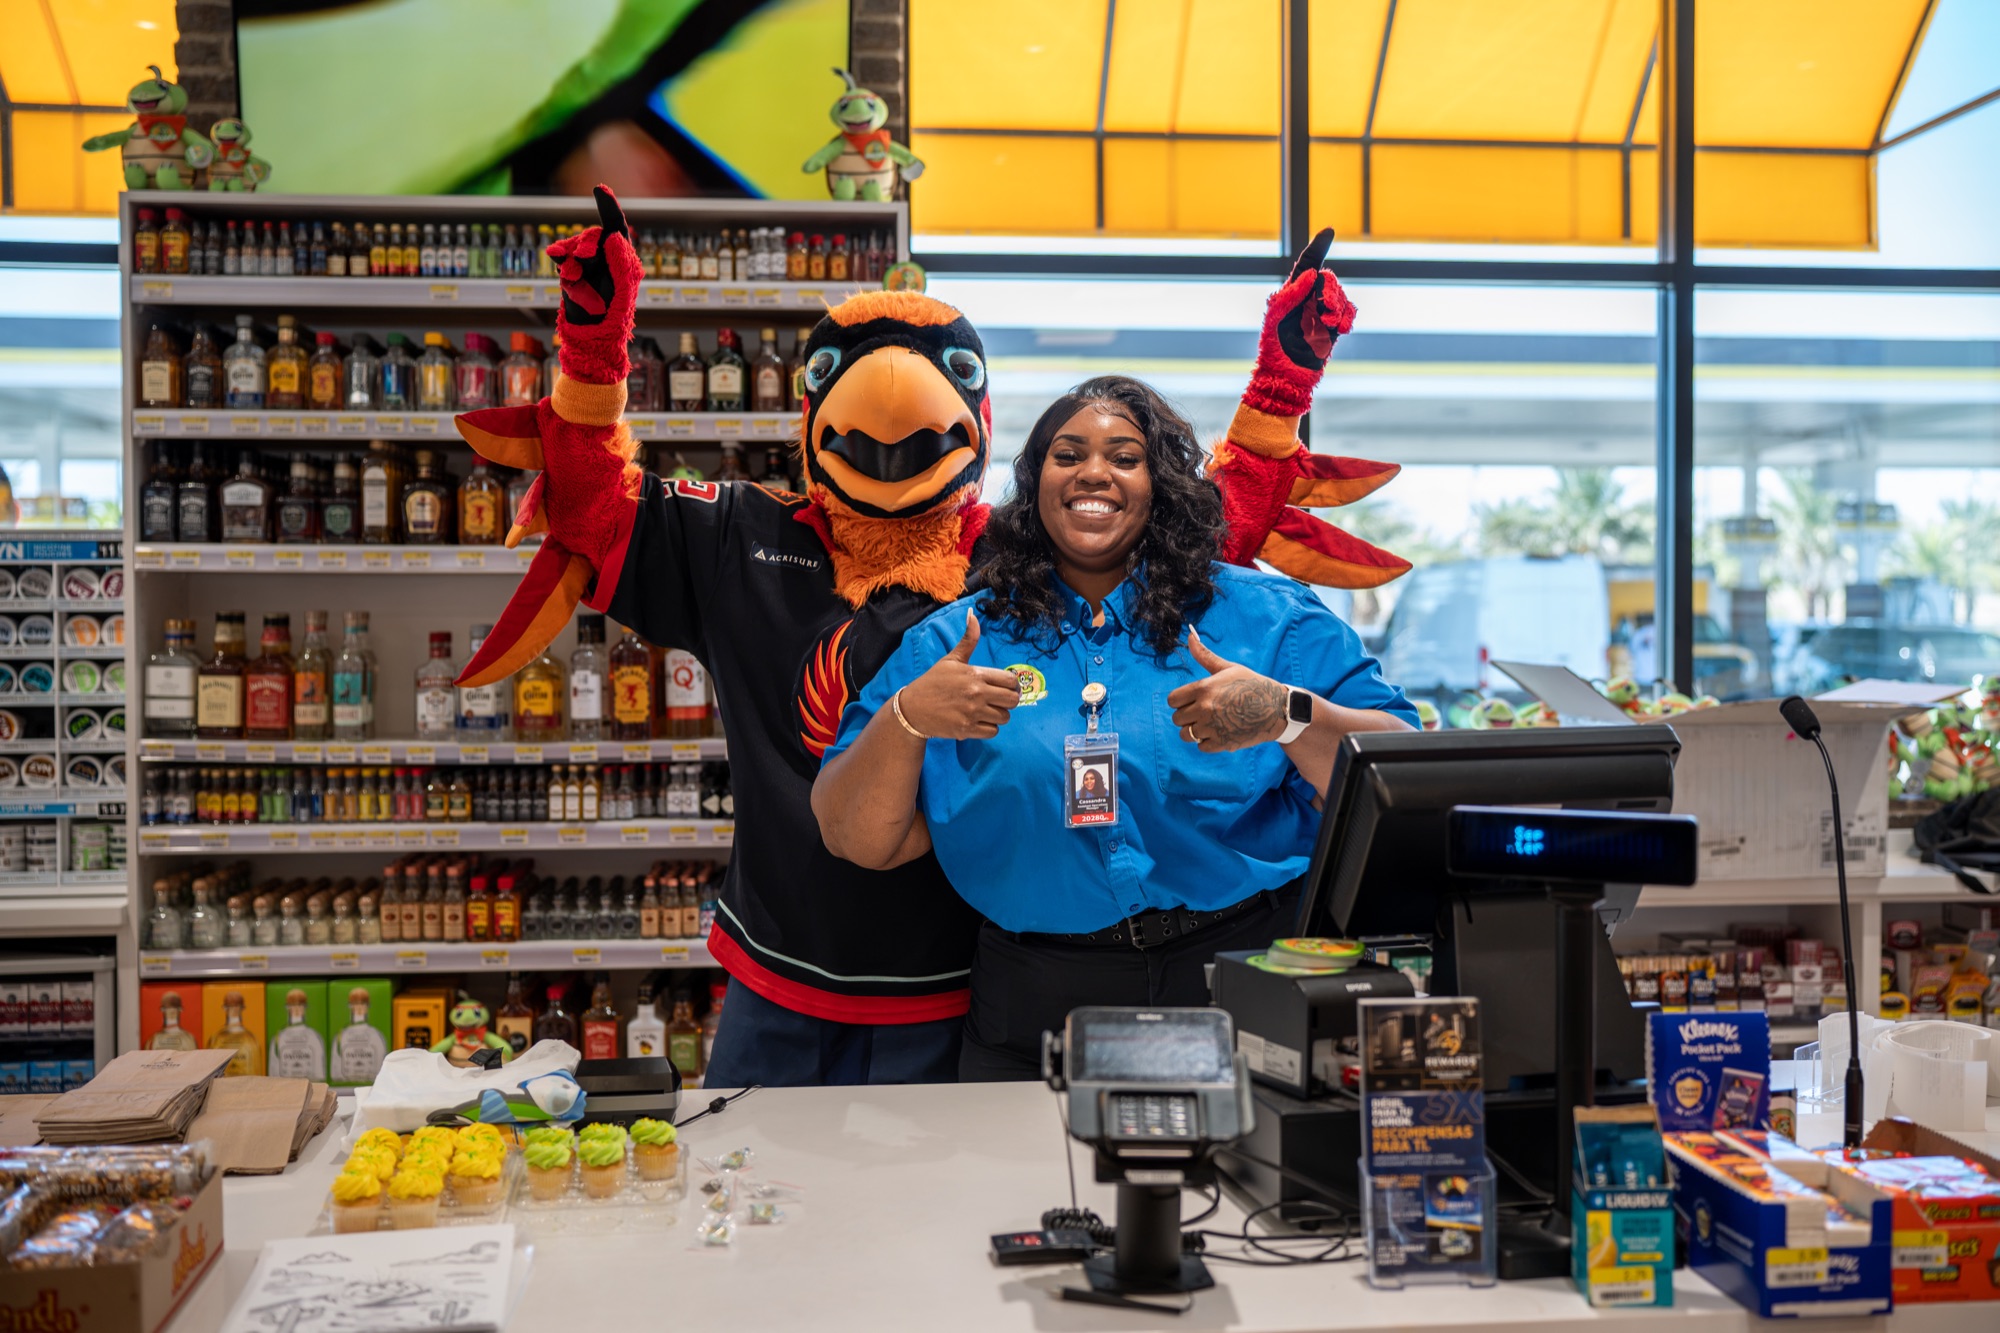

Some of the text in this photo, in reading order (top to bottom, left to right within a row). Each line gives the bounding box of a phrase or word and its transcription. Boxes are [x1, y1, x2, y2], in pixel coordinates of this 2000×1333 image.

[769, 554, 818, 568] ACRISURE
[673, 667, 695, 691] Q
[1345, 982, 1372, 992] EPSON
[1679, 1019, 1739, 1043] Kleenex
[1681, 1043, 1742, 1055] Pocket Pack
[1425, 1056, 1477, 1067] REWARDS
[1372, 1125, 1474, 1140] RECOMPENSAS
[1373, 1139, 1411, 1153] PARA
[1606, 1193, 1652, 1208] LIQUID
